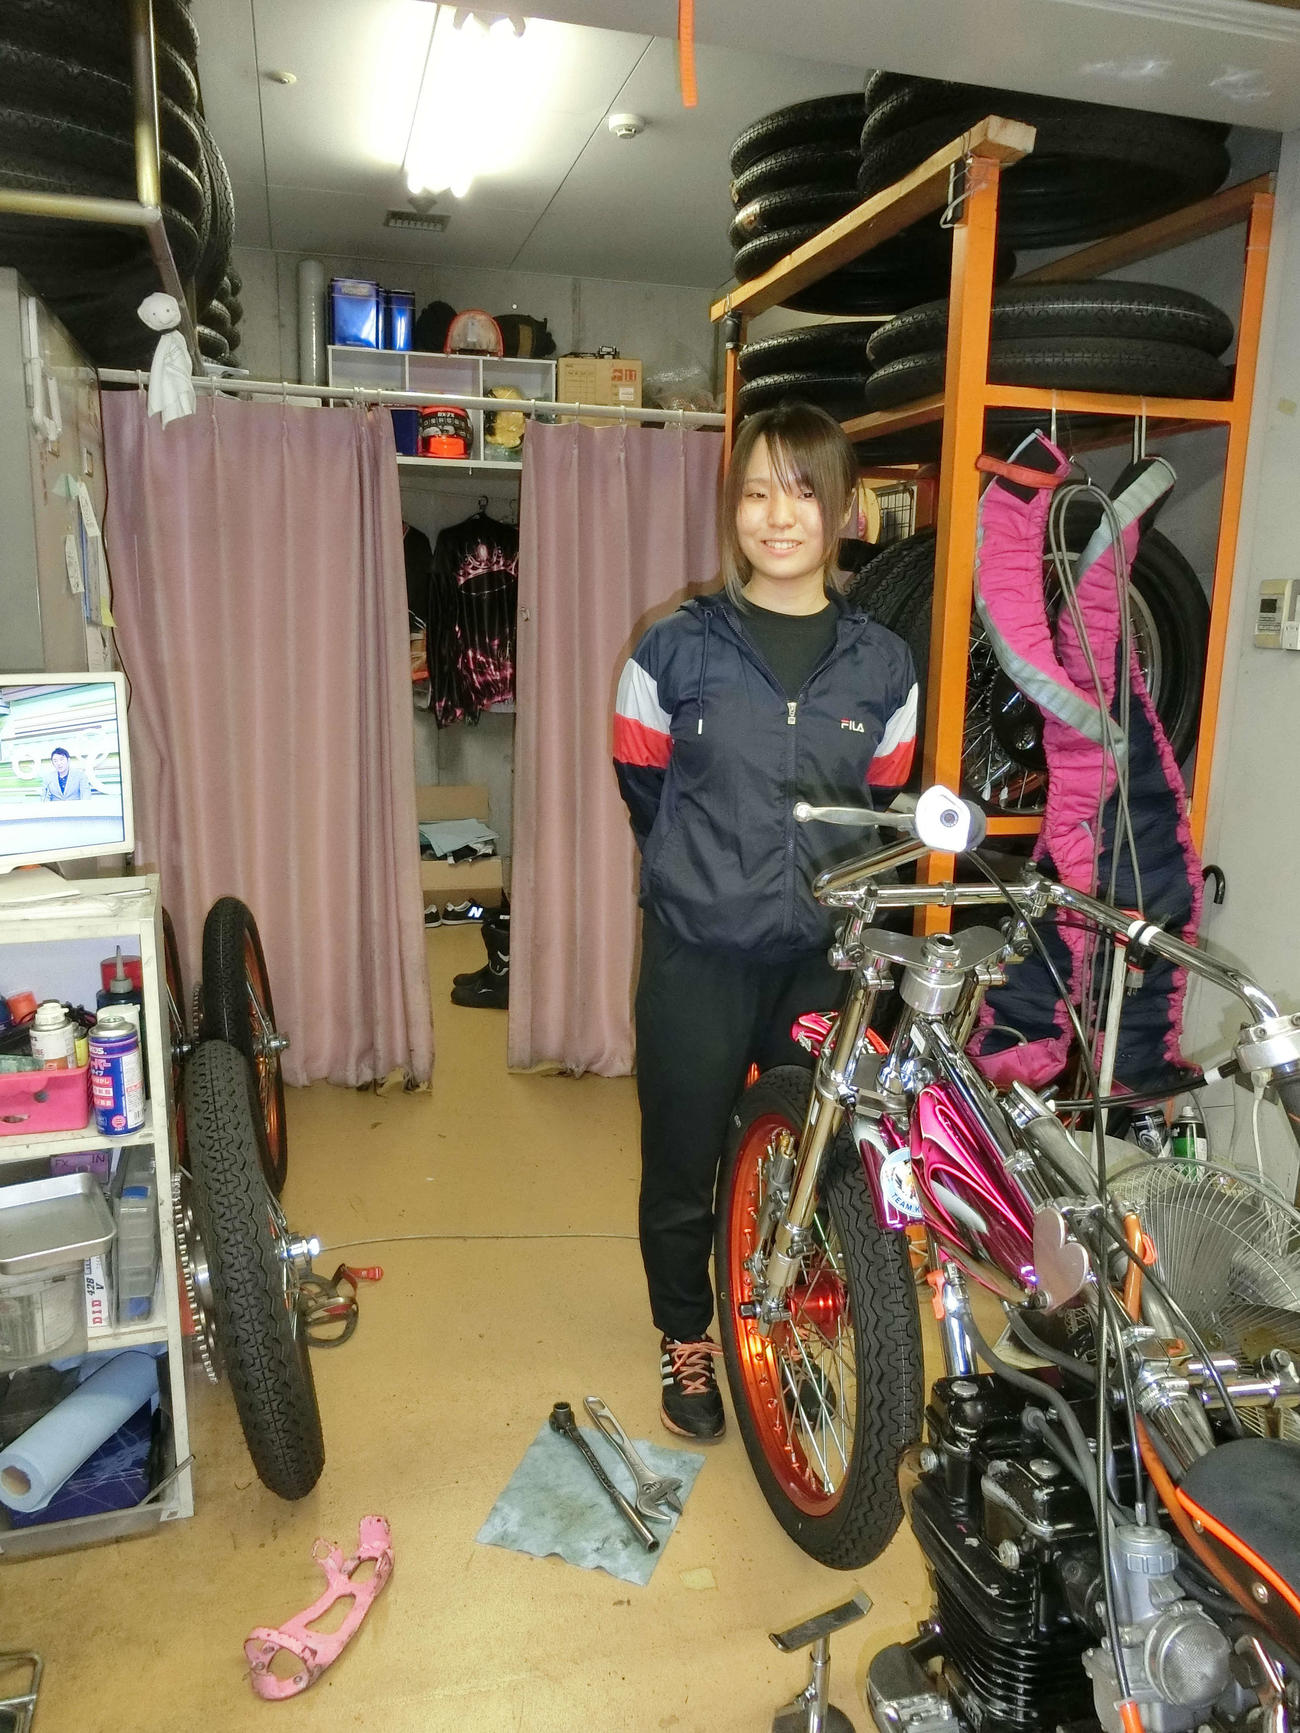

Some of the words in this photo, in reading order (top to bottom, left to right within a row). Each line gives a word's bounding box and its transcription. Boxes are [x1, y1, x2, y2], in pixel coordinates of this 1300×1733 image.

[841, 718, 865, 733] FILA
[468, 906, 484, 918] N
[91, 1153, 105, 1164] IN
[891, 1191, 913, 1212] TEAM
[91, 1299, 103, 1324] DID
